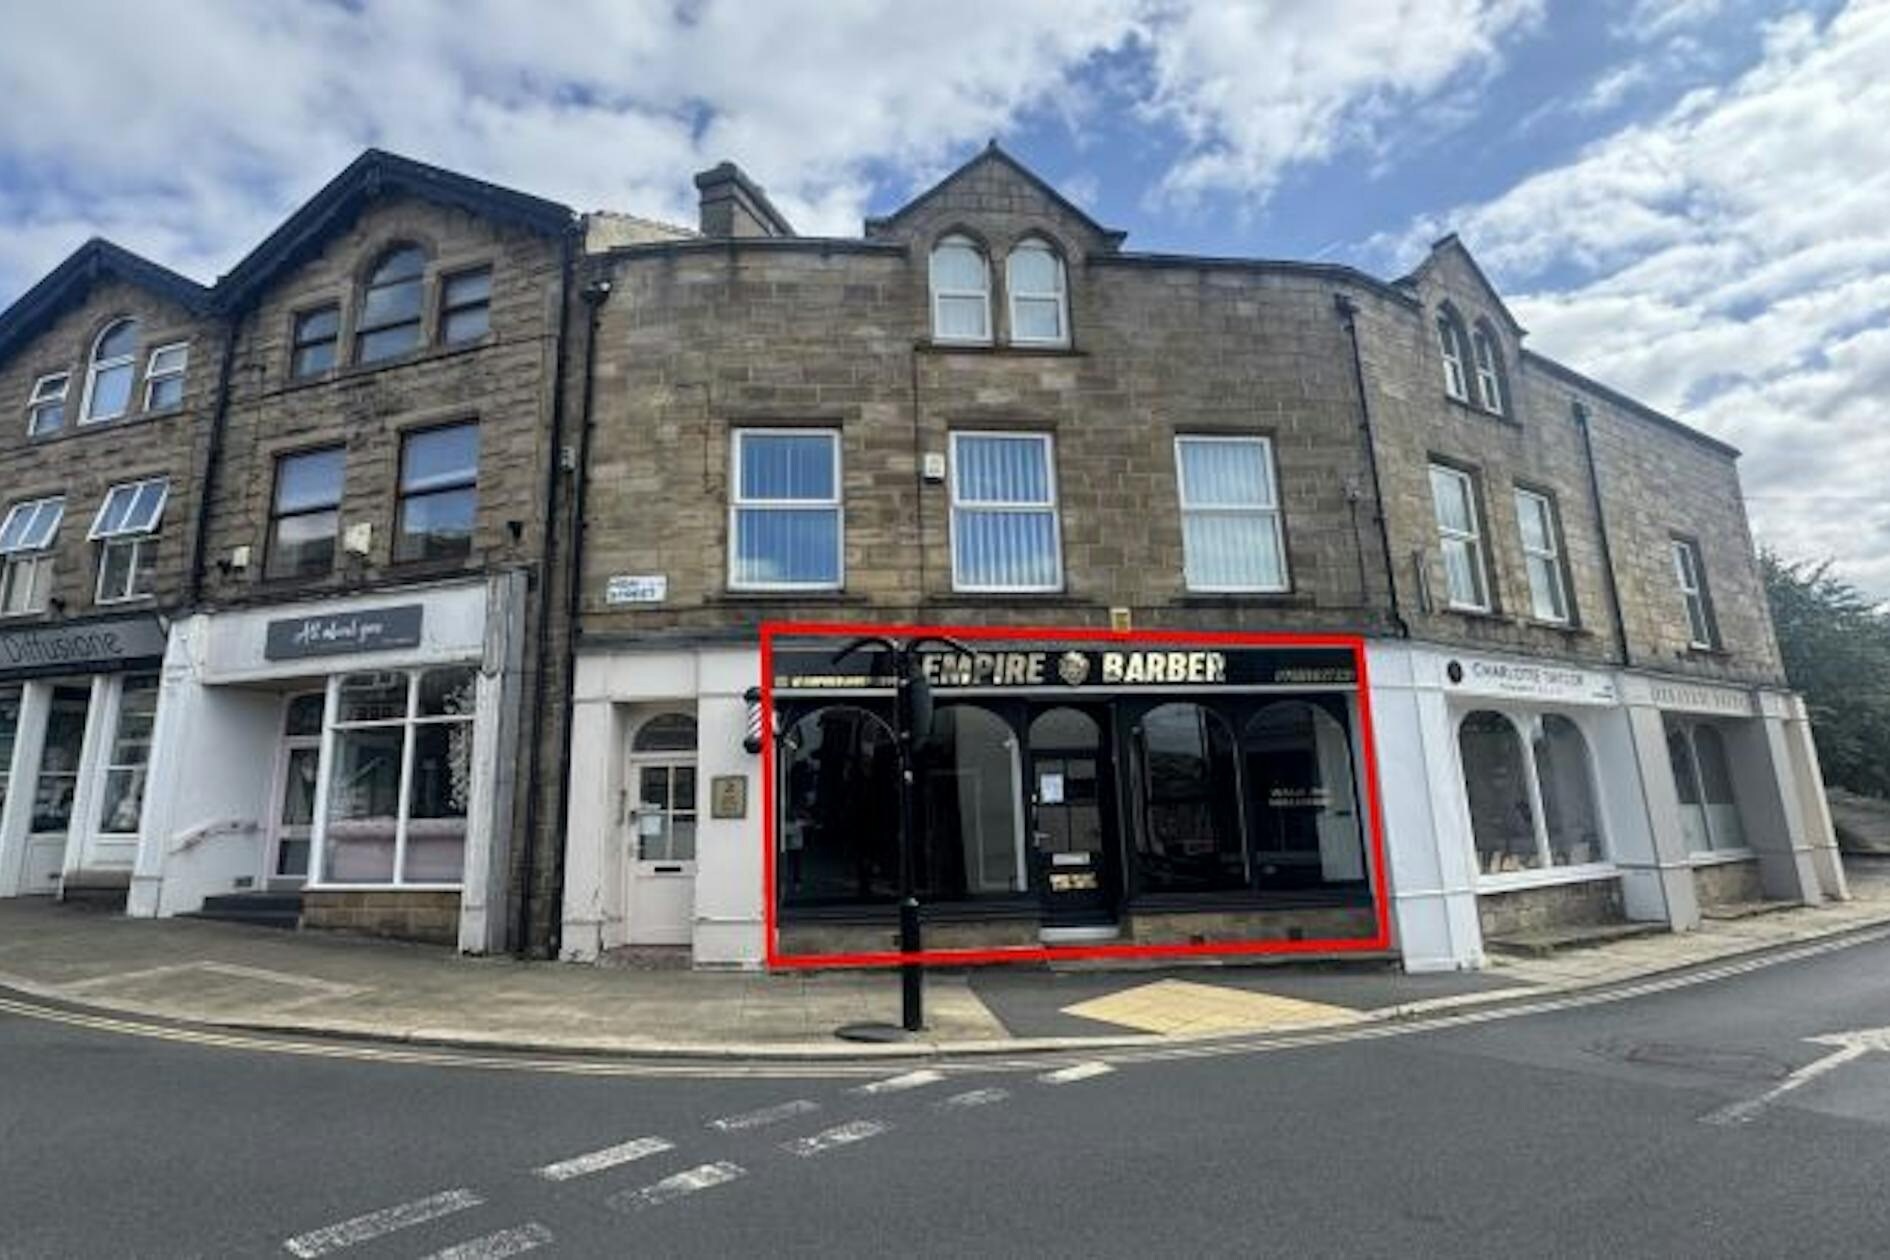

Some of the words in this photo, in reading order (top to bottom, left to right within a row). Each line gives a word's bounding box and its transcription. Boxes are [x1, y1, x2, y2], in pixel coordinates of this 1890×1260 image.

[3, 630, 125, 663] Diffusione
[921, 651, 1046, 685] EMPIRE
[1101, 651, 1226, 684] BARBER
